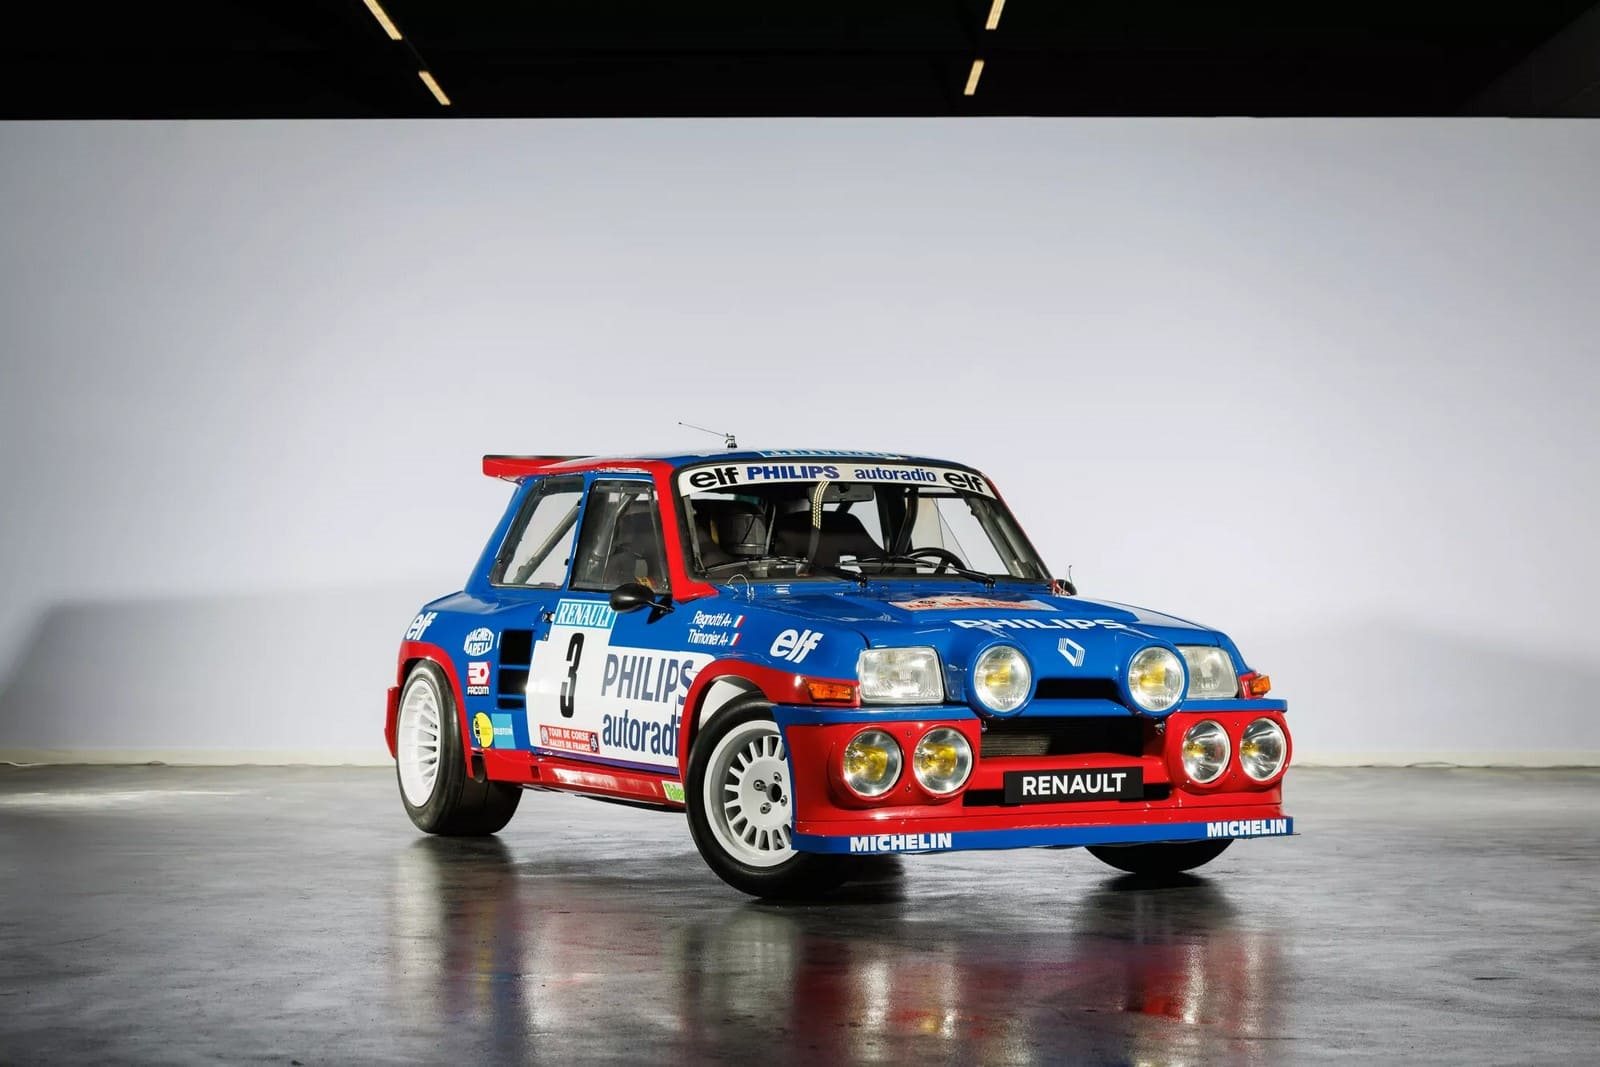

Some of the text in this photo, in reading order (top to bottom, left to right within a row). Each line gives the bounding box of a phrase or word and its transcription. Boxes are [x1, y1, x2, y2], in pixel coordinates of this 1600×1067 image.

[690, 466, 983, 493] elf PHILIPS autoradio elf
[406, 611, 438, 640] elf
[556, 602, 614, 628] RENAULT
[951, 619, 1129, 630] PHILIPS
[770, 629, 824, 664] elf
[560, 632, 585, 719] 3
[601, 653, 694, 705] PHILIPS
[548, 727, 590, 741] TOUR DE CORSE
[602, 709, 682, 758] autoradi
[1022, 773, 1127, 796] RENAULT
[1207, 818, 1287, 837] MICHELIN
[850, 832, 952, 852] MICHELIN
